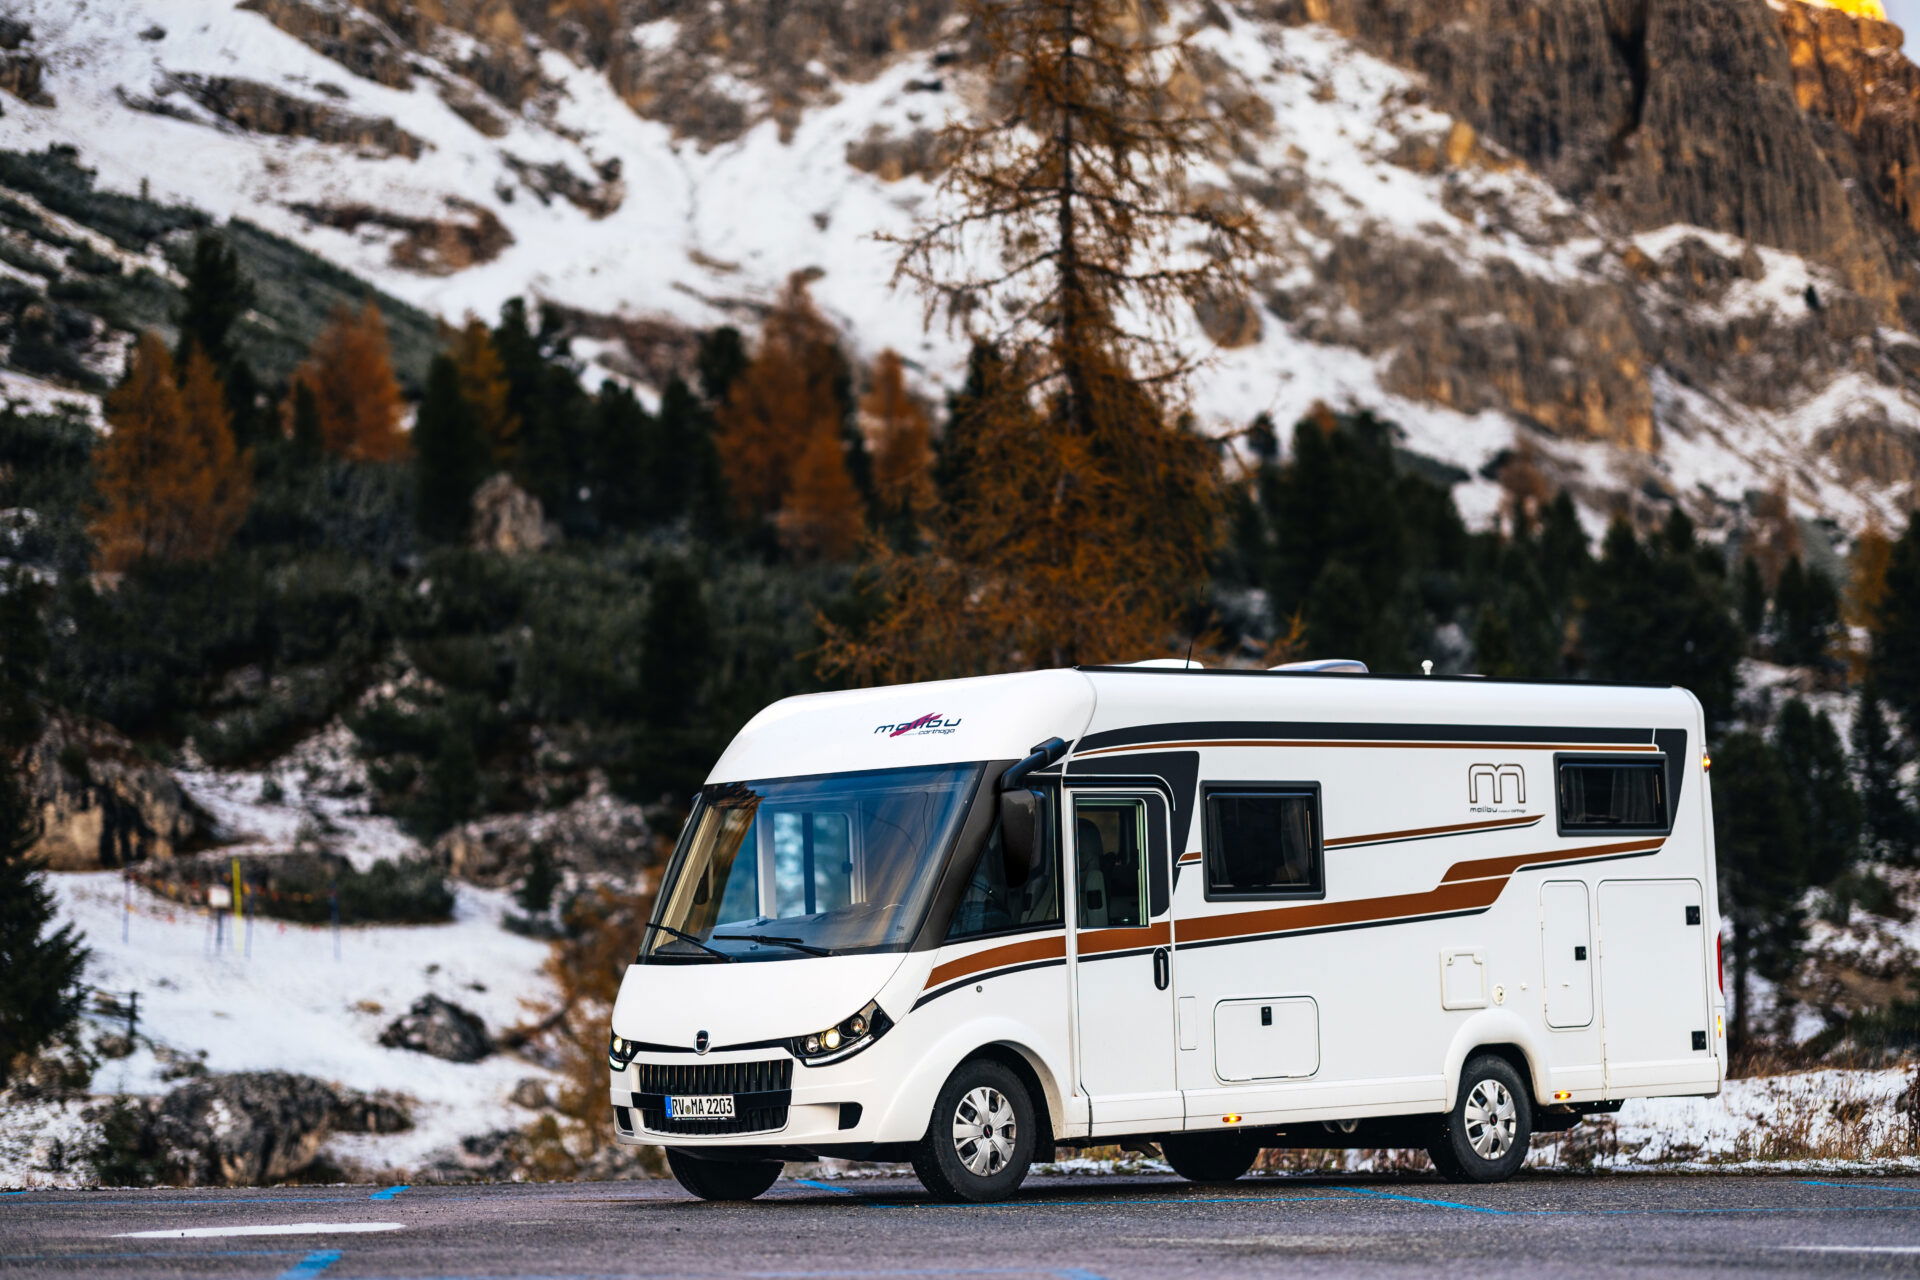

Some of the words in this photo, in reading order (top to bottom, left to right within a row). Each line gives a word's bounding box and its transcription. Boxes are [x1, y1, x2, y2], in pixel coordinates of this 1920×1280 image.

[874, 718, 962, 734] malibu
[672, 1099, 684, 1114] RV
[690, 1098, 704, 1114] MA
[706, 1098, 732, 1114] 2203
